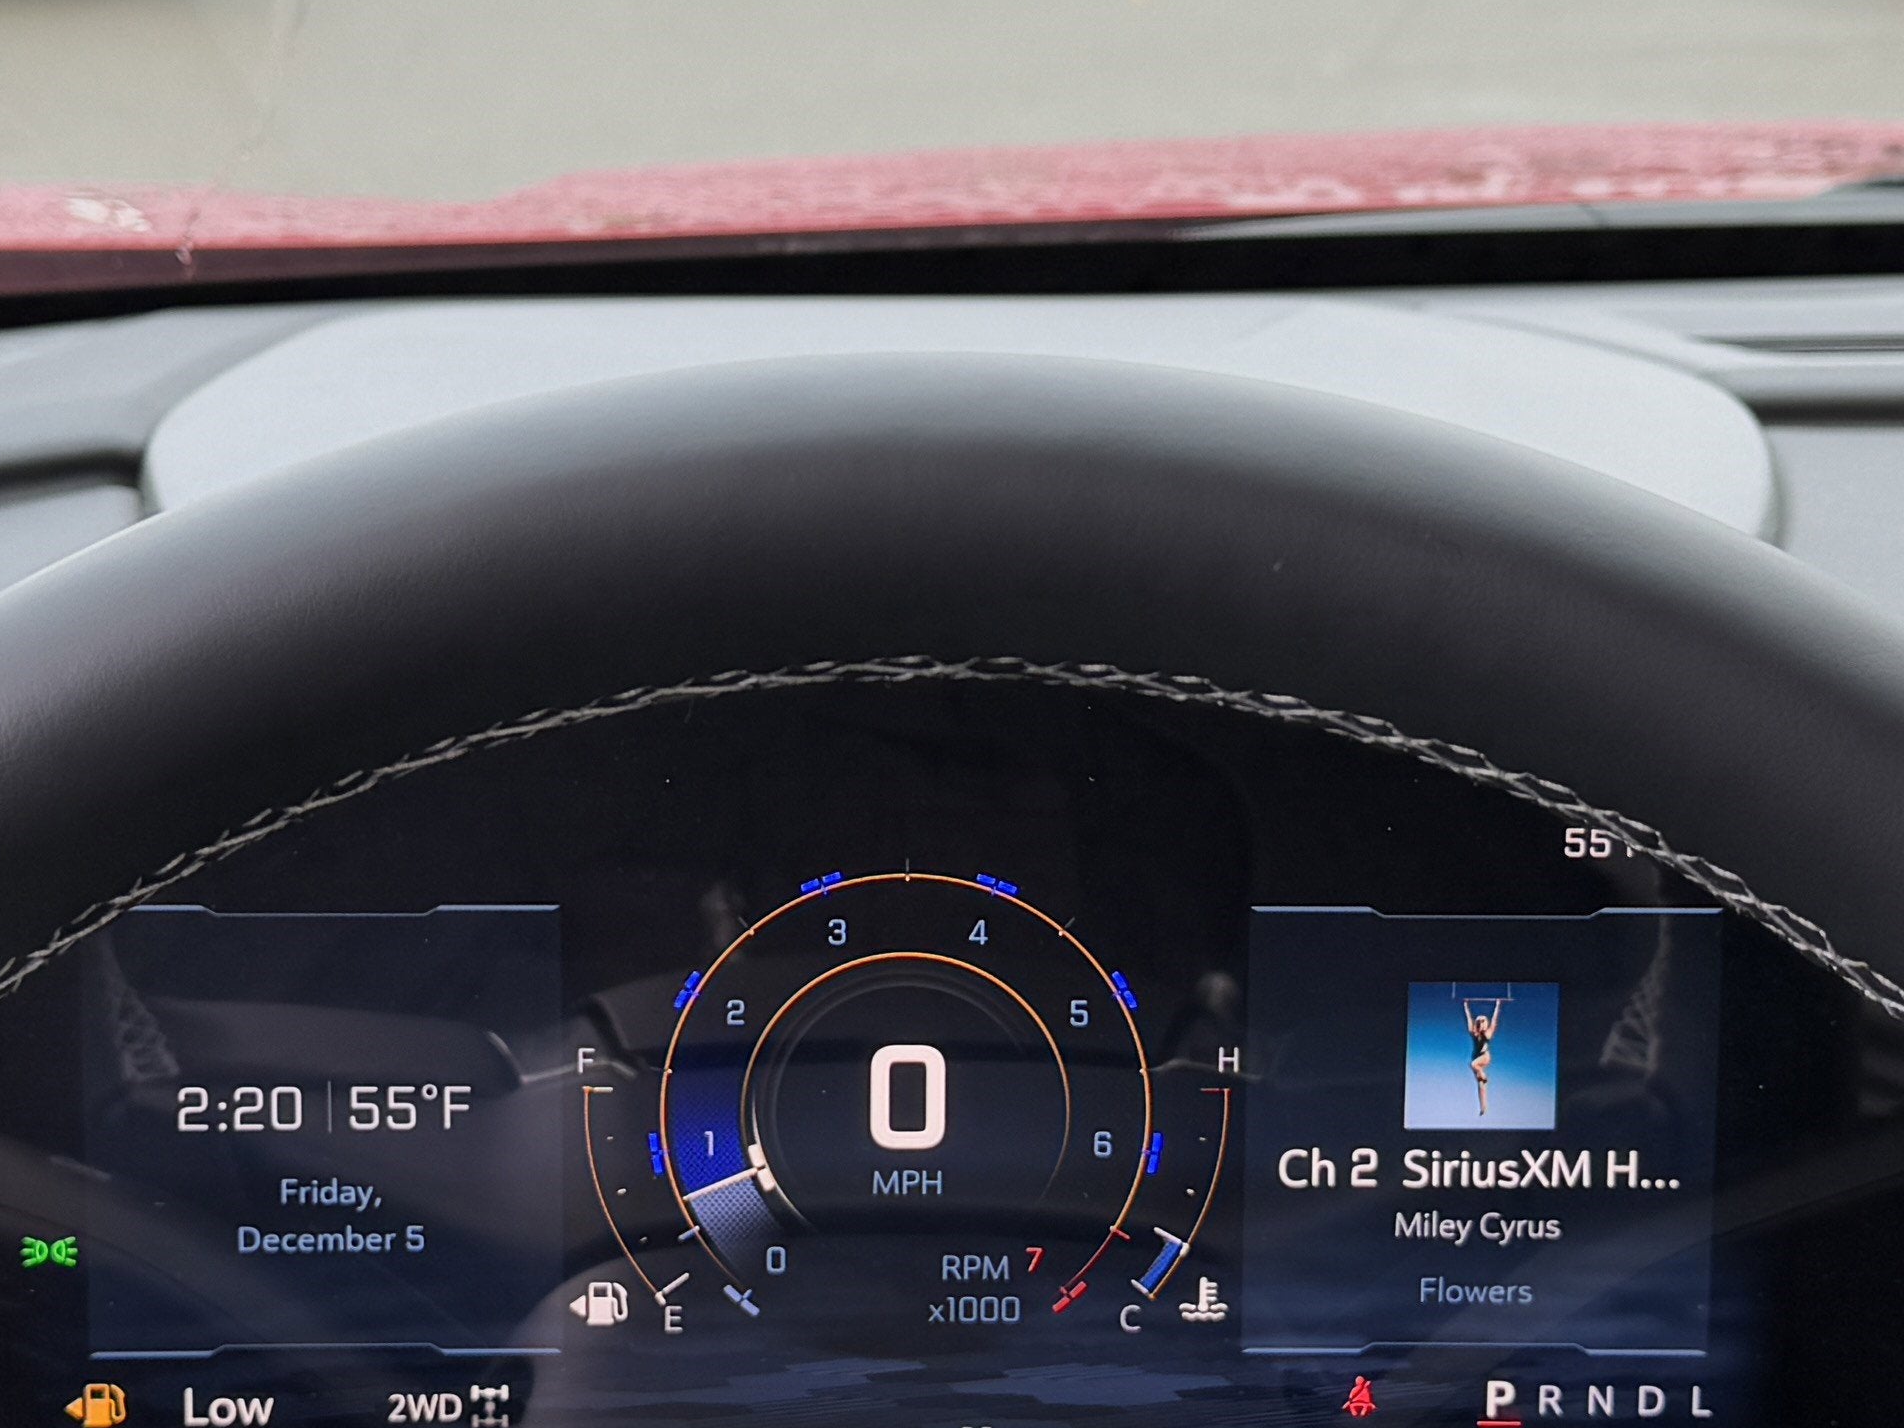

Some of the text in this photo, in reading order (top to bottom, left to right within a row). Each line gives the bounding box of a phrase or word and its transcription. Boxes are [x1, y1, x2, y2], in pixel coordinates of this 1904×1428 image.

[827, 918, 847, 946] 3
[968, 919, 989, 946] 4
[726, 999, 746, 1026] 2
[1069, 999, 1089, 1027] 5
[577, 1047, 596, 1074] F
[1218, 1046, 1240, 1073] H
[177, 1083, 472, 1132] 2:20 55°F
[869, 1044, 947, 1150] 0
[704, 1130, 715, 1158] 1
[1093, 1130, 1113, 1158] 6
[1278, 1146, 1336, 1188] Ch
[1350, 1147, 1378, 1188] 2
[1402, 1148, 1591, 1189] SiriusXM
[280, 1177, 382, 1212] Friday,
[872, 1169, 943, 1195] MPH
[237, 1224, 425, 1254] December 5
[1394, 1210, 1562, 1246] Miley Cyrus
[766, 1246, 787, 1275] 0
[942, 1254, 1010, 1281] RPM
[1026, 1246, 1043, 1272] 7
[1420, 1276, 1534, 1306] Flowers
[664, 1305, 683, 1333] E
[928, 1295, 1021, 1324] x1000
[1119, 1304, 1141, 1332] C
[184, 1386, 275, 1427] Low
[388, 1393, 463, 1422] 2WD
[1486, 1380, 1712, 1419] P R N D L
